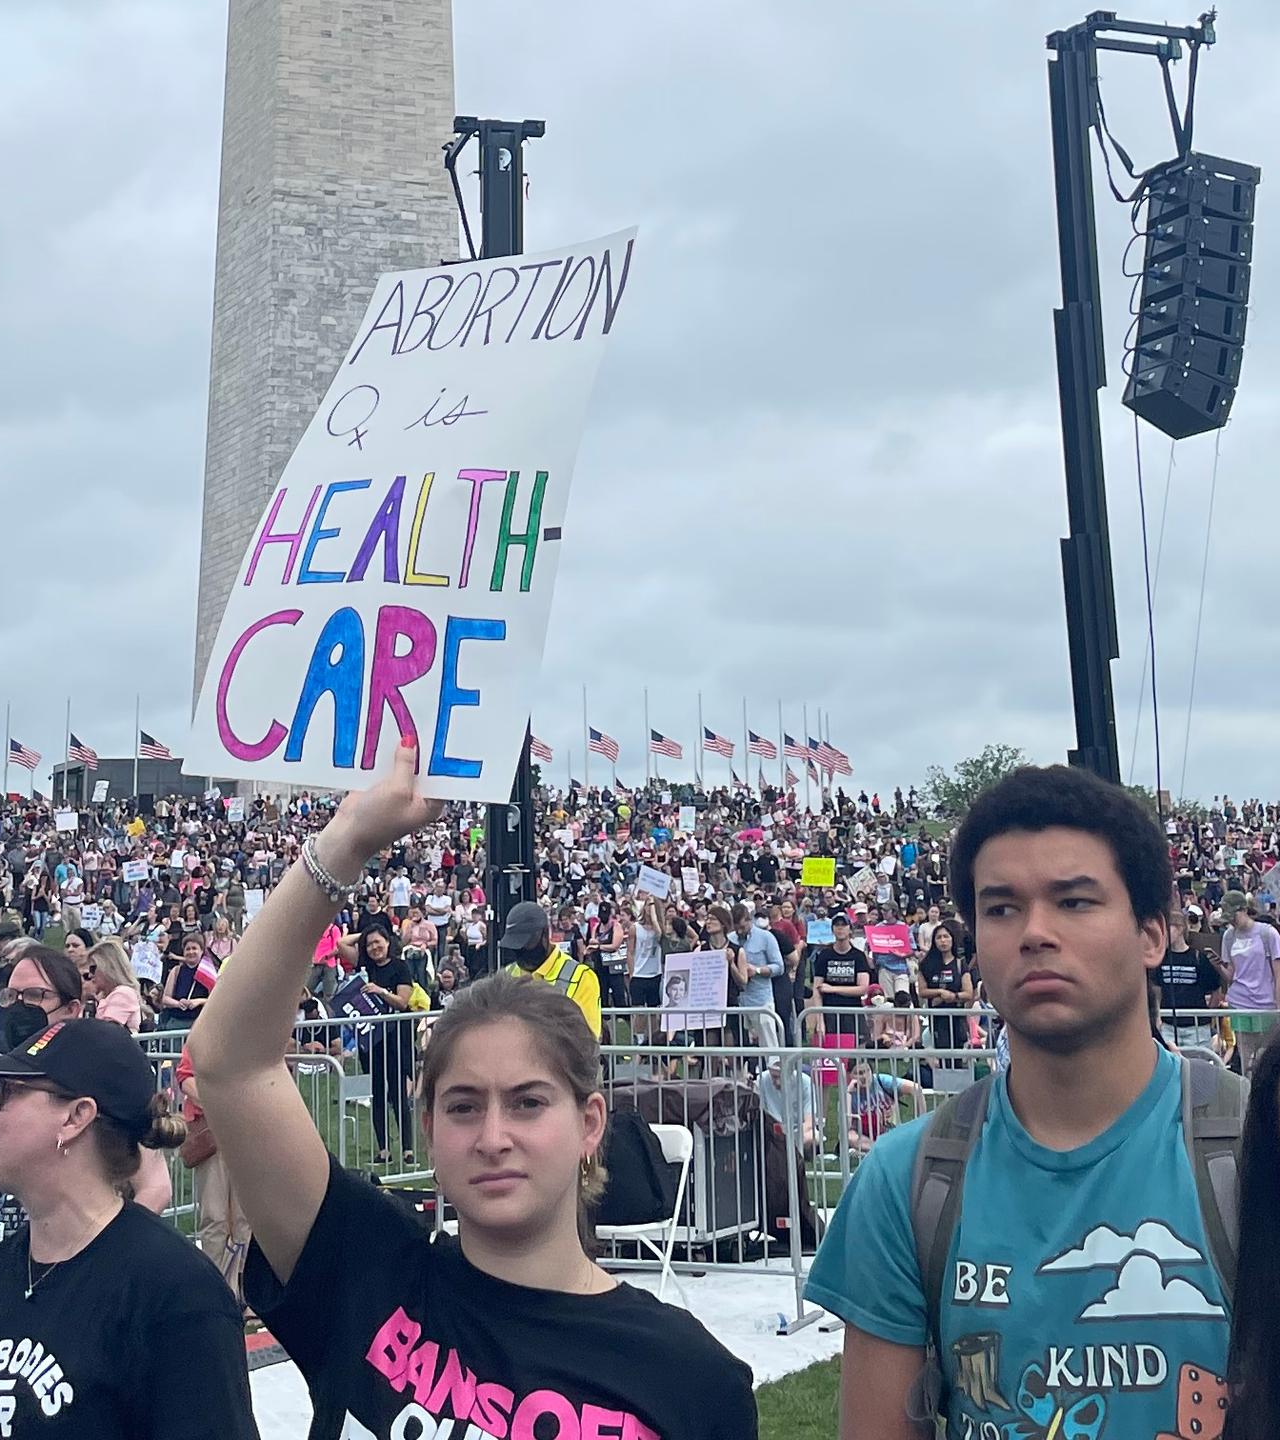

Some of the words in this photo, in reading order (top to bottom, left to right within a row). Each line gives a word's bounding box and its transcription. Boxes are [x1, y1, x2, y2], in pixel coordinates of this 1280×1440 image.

[349, 238, 635, 365] ABORTION
[404, 387, 489, 431] is
[216, 605, 507, 779] CARE
[953, 1260, 1013, 1305] BE
[365, 1305, 516, 1439] BANS
[1045, 1344, 1168, 1388] KIND
